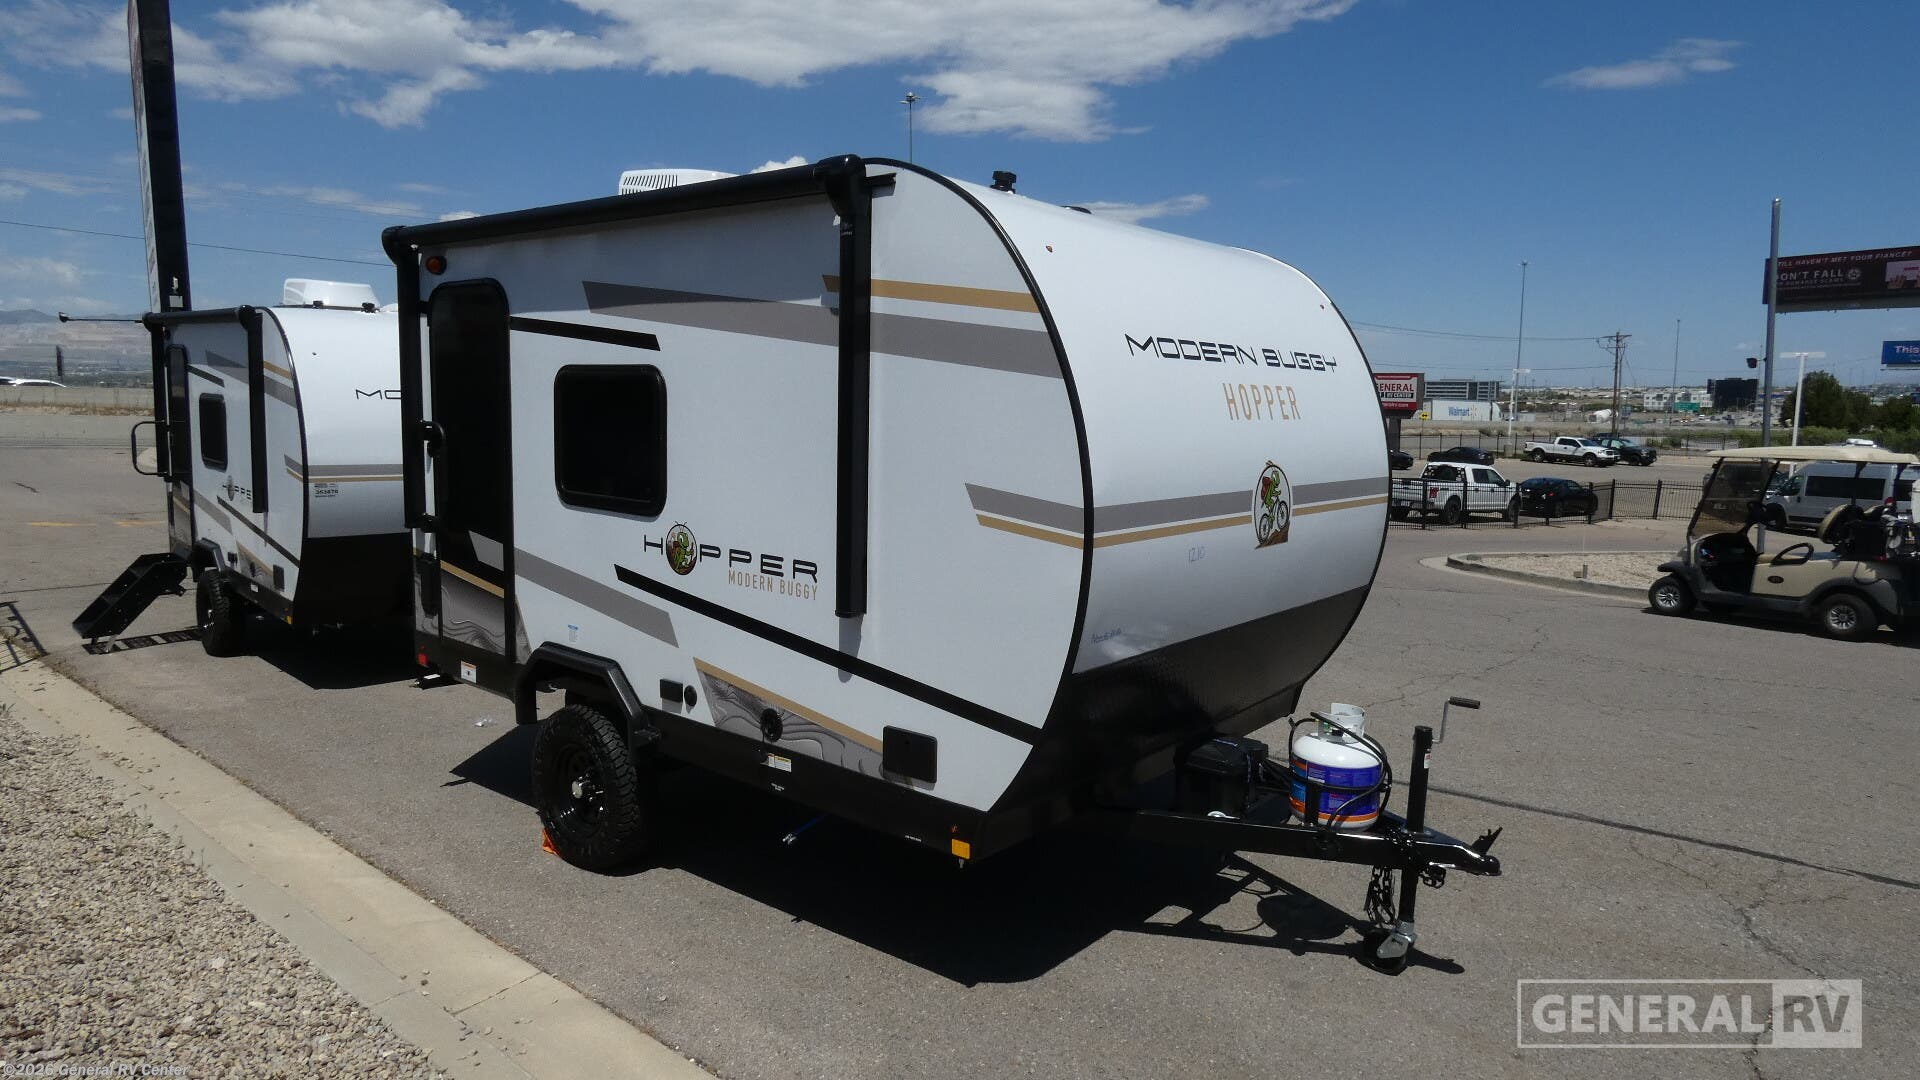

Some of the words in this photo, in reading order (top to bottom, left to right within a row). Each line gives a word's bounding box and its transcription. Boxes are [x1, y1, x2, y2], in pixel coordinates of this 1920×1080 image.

[1776, 271, 1809, 281] ON'T
[1813, 269, 1844, 279] FALL
[1125, 333, 1258, 366] MODERN
[1261, 348, 1338, 373] BUGGY
[1894, 345, 1920, 354] This
[1222, 382, 1301, 421] HOPPER
[728, 569, 774, 593] MODERN
[780, 578, 818, 601] BUGGY
